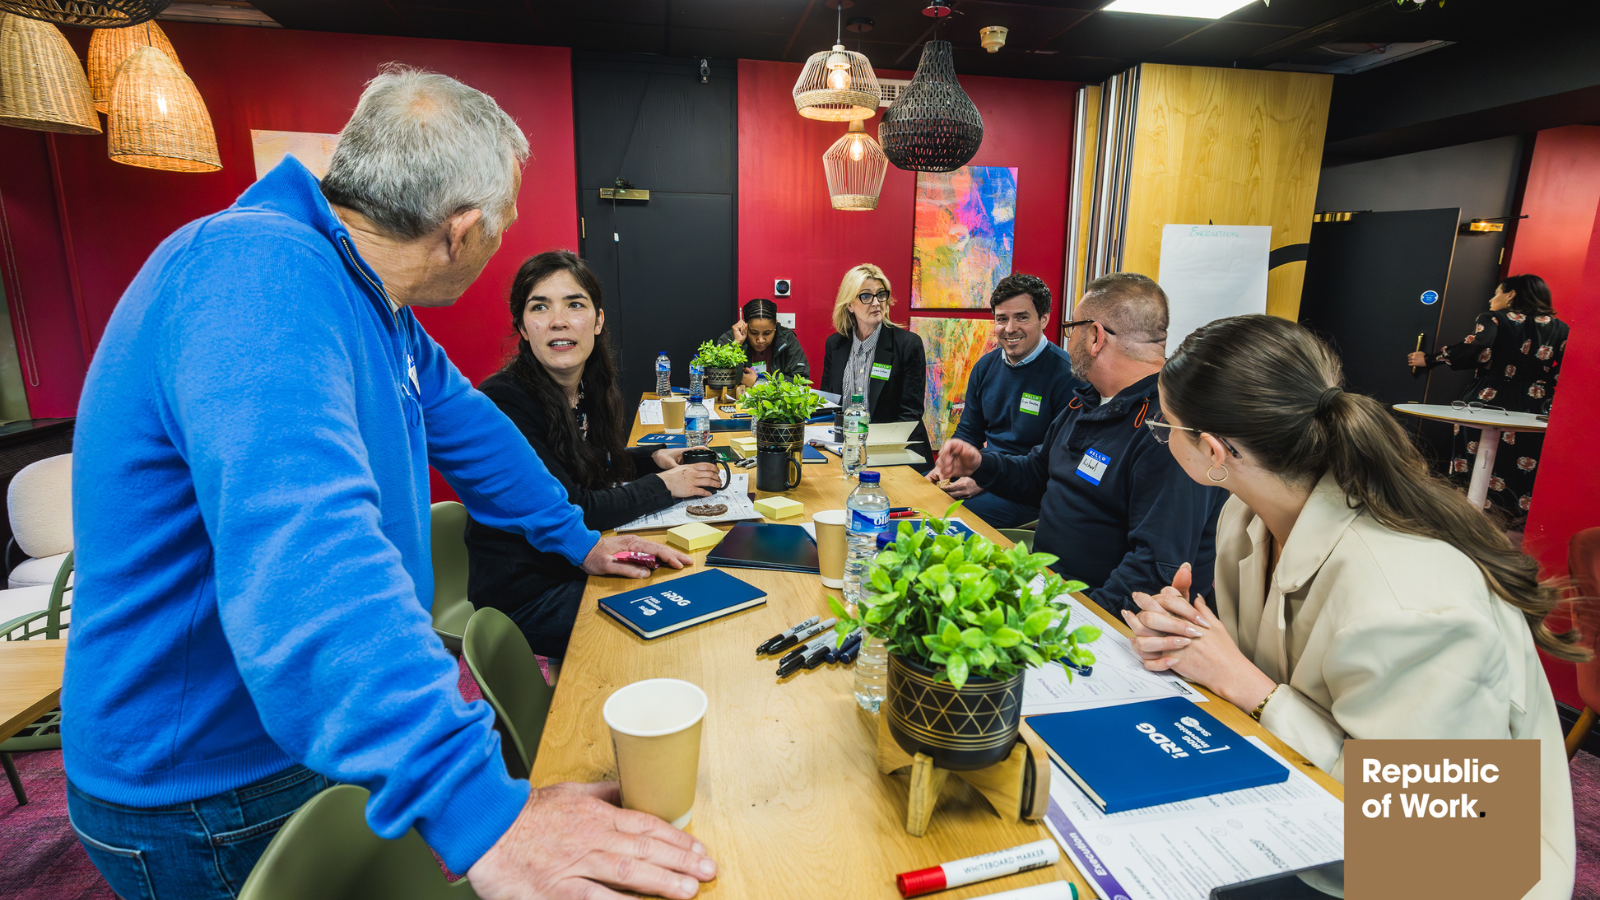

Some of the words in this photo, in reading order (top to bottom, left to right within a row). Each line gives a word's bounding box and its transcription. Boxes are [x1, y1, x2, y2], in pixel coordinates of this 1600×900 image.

[1089, 450, 1106, 461] HELLO
[1135, 722, 1190, 759] iRDG
[1173, 722, 1210, 749] Innovation
[963, 857, 1015, 874] WHITEBOARD
[1016, 849, 1046, 862] MARKER
[1069, 832, 1108, 877] Execution
